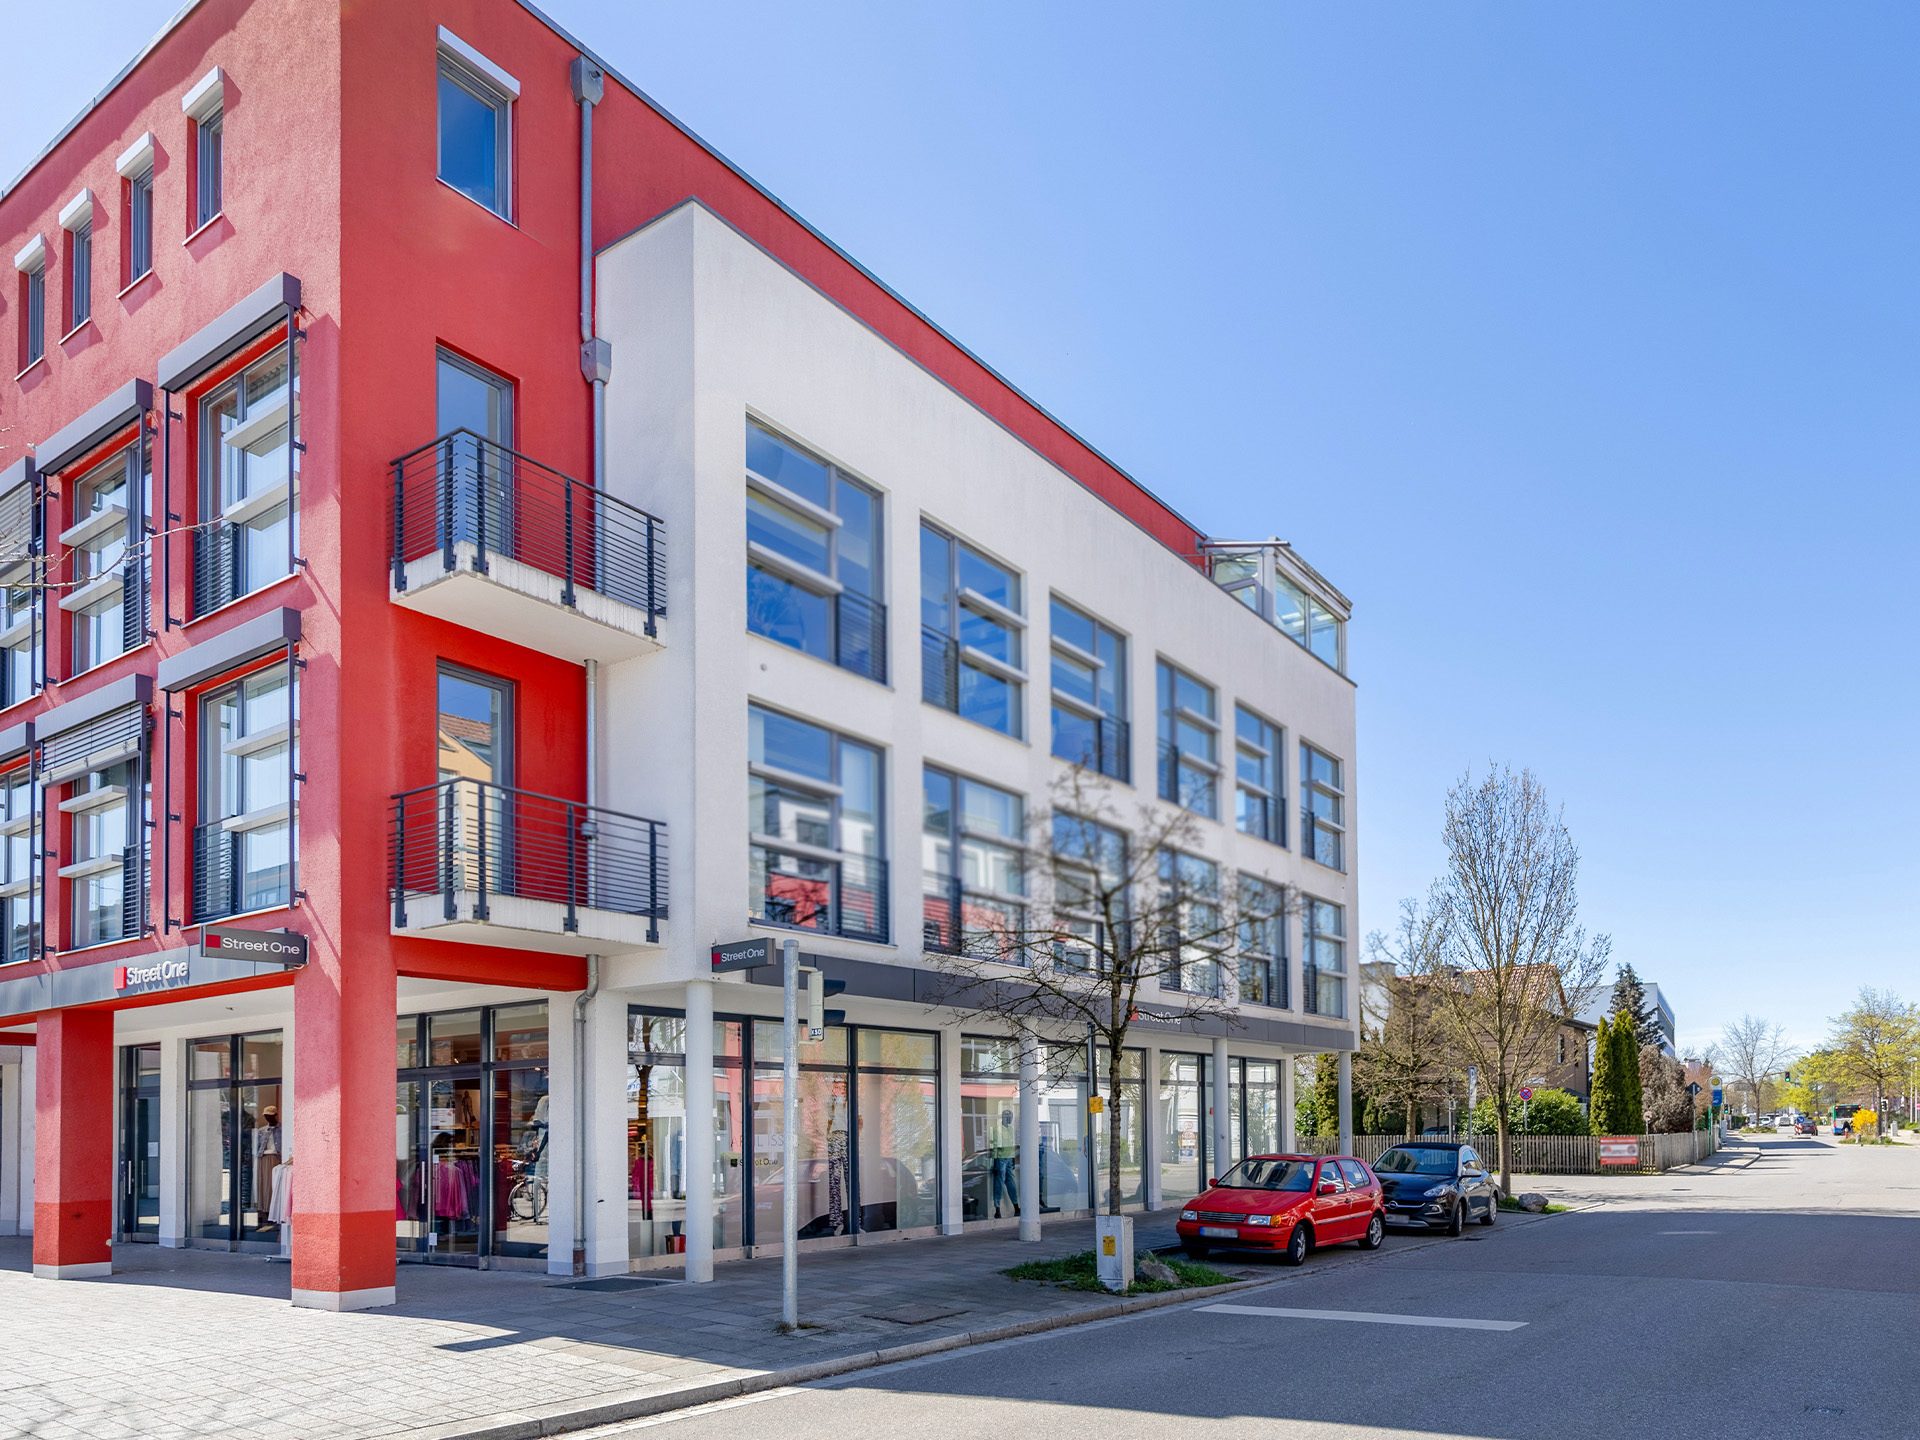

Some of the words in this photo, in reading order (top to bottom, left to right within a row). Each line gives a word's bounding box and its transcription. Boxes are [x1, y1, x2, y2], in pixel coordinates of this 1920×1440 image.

[222, 937, 268, 952] Street
[270, 942, 300, 955] One
[721, 949, 747, 962] Street
[747, 948, 765, 958] One
[126, 963, 162, 985] Street
[161, 960, 187, 979] One
[1164, 1011, 1181, 1024] One
